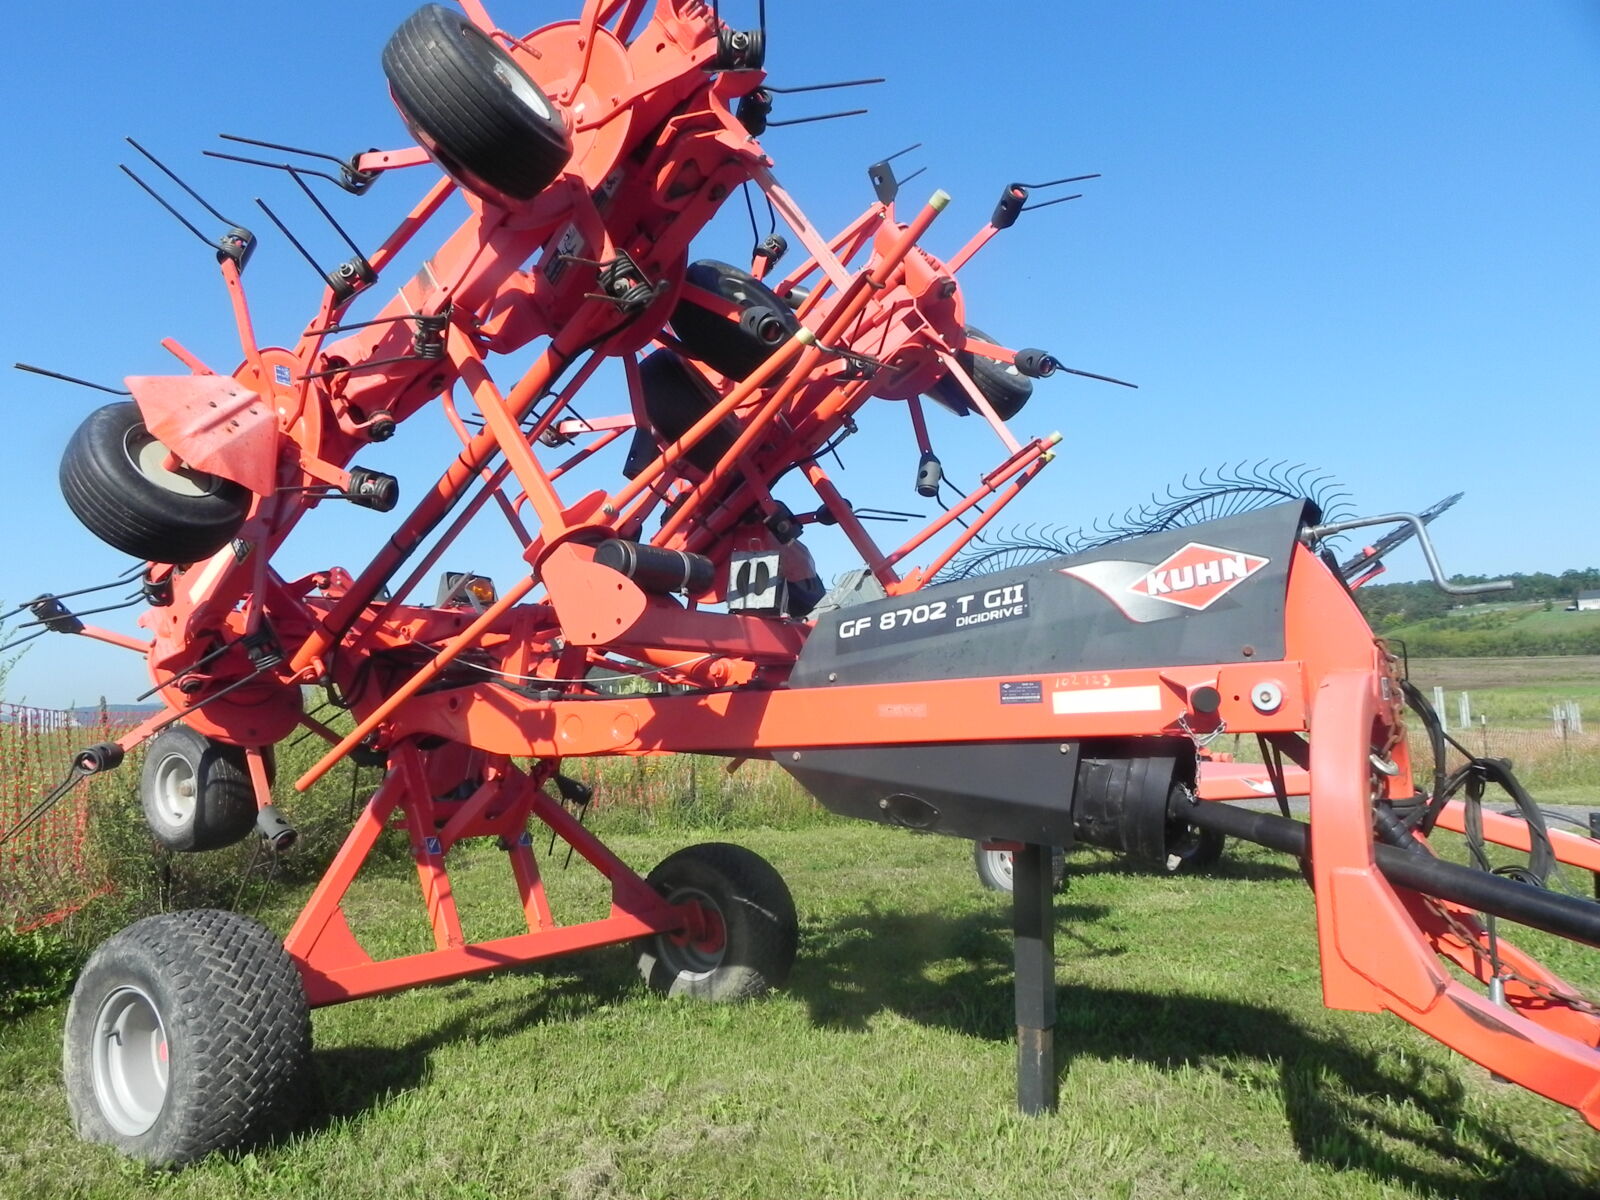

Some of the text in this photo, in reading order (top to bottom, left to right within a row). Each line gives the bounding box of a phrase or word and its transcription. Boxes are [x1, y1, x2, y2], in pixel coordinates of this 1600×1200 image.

[1146, 554, 1248, 596] KUHN
[839, 584, 1024, 639] GF 8702 T GII
[956, 604, 1024, 627] DIGIDRIVE
